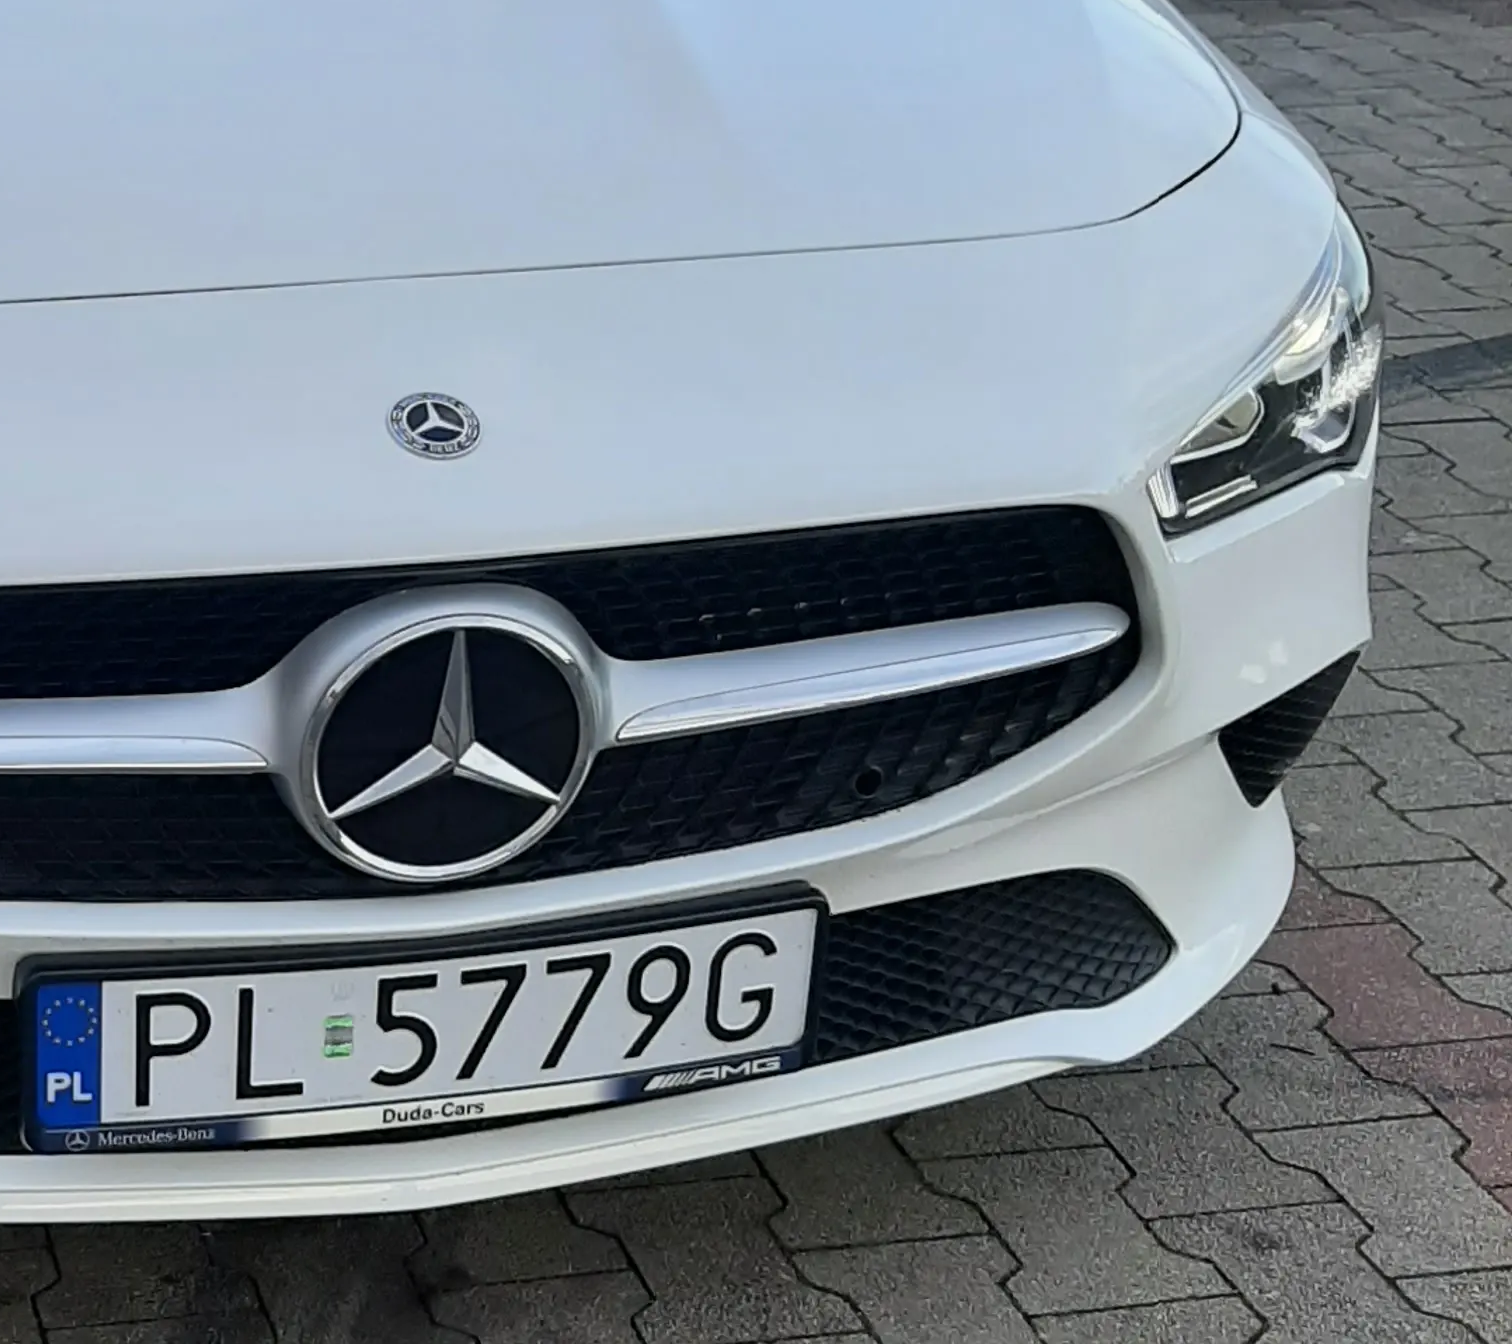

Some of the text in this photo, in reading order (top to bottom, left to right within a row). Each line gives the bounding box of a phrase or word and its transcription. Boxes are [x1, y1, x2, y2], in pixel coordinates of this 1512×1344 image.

[134, 931, 779, 1107] PL 5779G
[687, 1056, 782, 1085] AMG
[45, 1071, 93, 1104] PL
[382, 1100, 486, 1124] Duda-Cars
[97, 1127, 216, 1147] Mercedes-Benz
